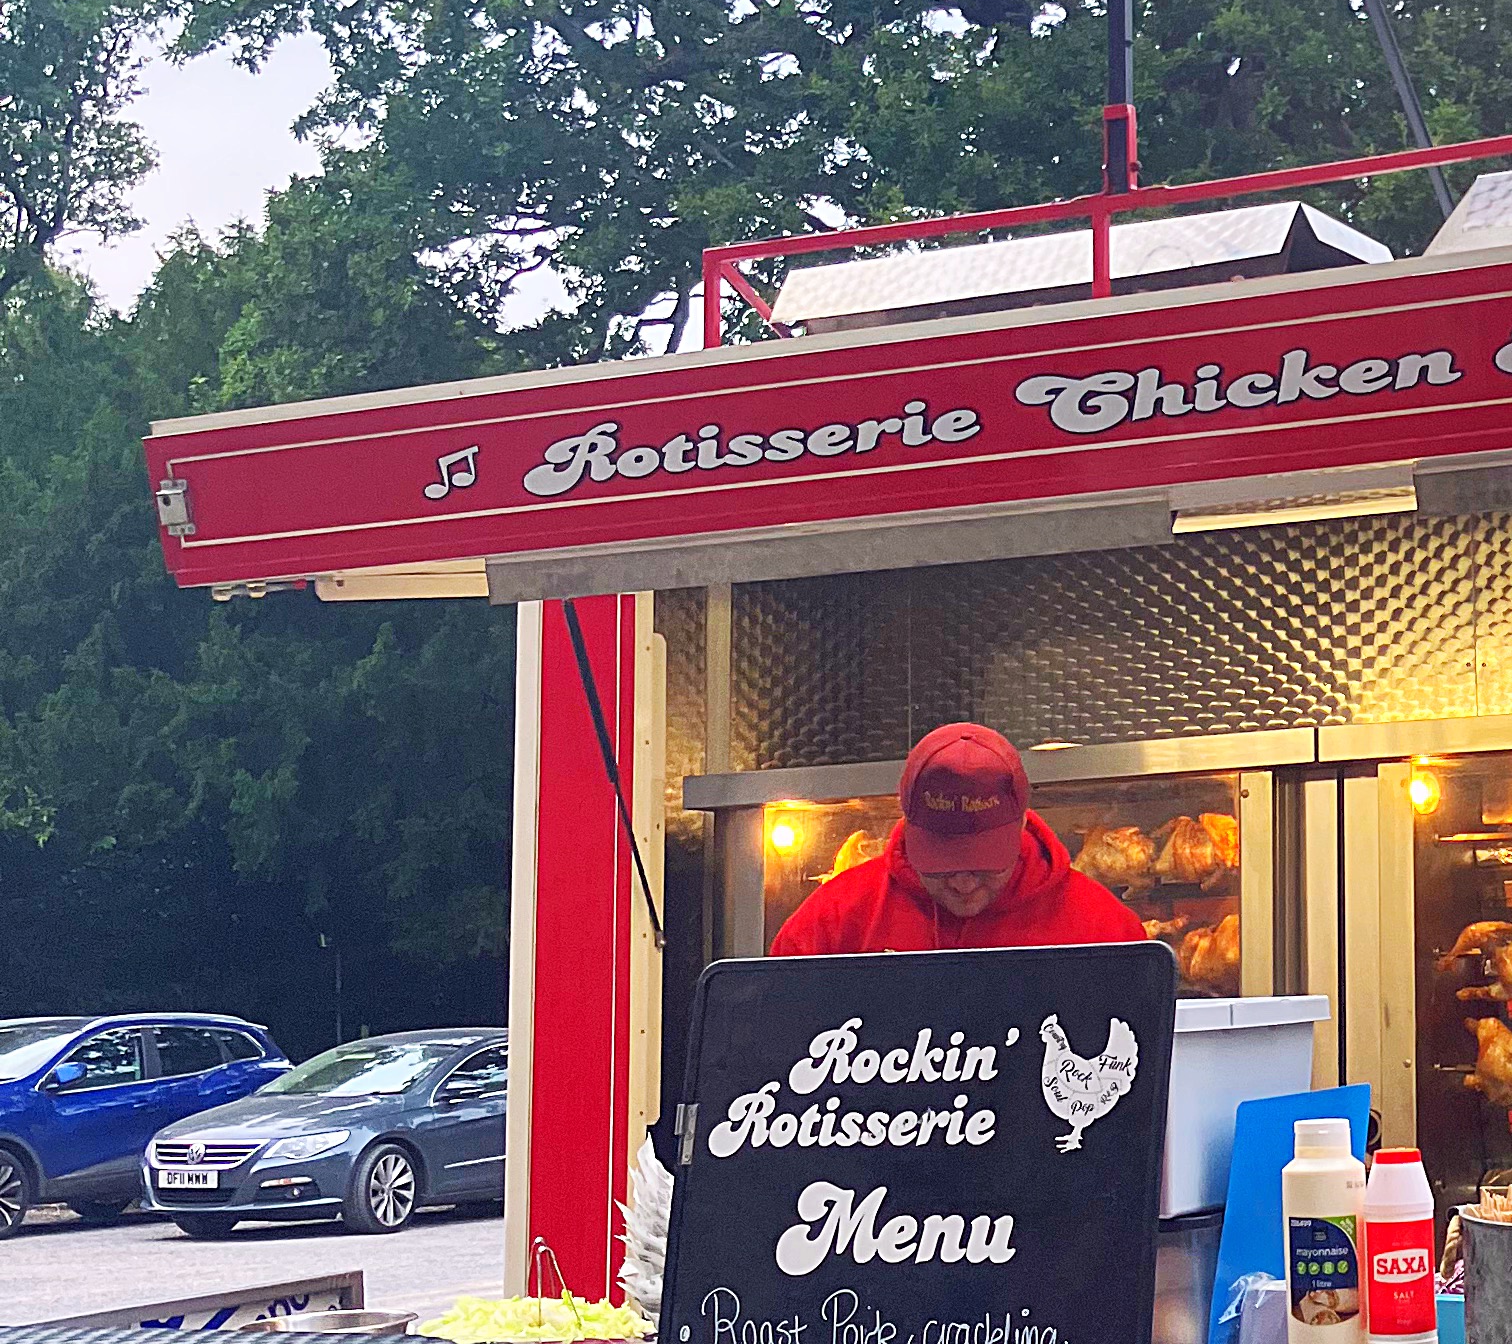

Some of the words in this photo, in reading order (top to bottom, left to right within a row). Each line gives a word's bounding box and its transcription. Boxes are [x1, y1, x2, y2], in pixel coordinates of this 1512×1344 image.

[522, 400, 981, 497] Rotisserie
[1015, 349, 1463, 435] Chicken
[789, 1017, 1020, 1095] Rockin'
[1099, 1054, 1132, 1077] Funk
[1060, 1059, 1093, 1091] Rock
[1043, 1076, 1068, 1102] Soul
[708, 1081, 996, 1158] Rotisserie
[1070, 1099, 1094, 1116] Pop
[776, 1181, 1017, 1276] Menu
[1296, 1246, 1349, 1259] mayonnaise
[1376, 1256, 1427, 1275] SAXA
[1393, 1290, 1415, 1300] SALT
